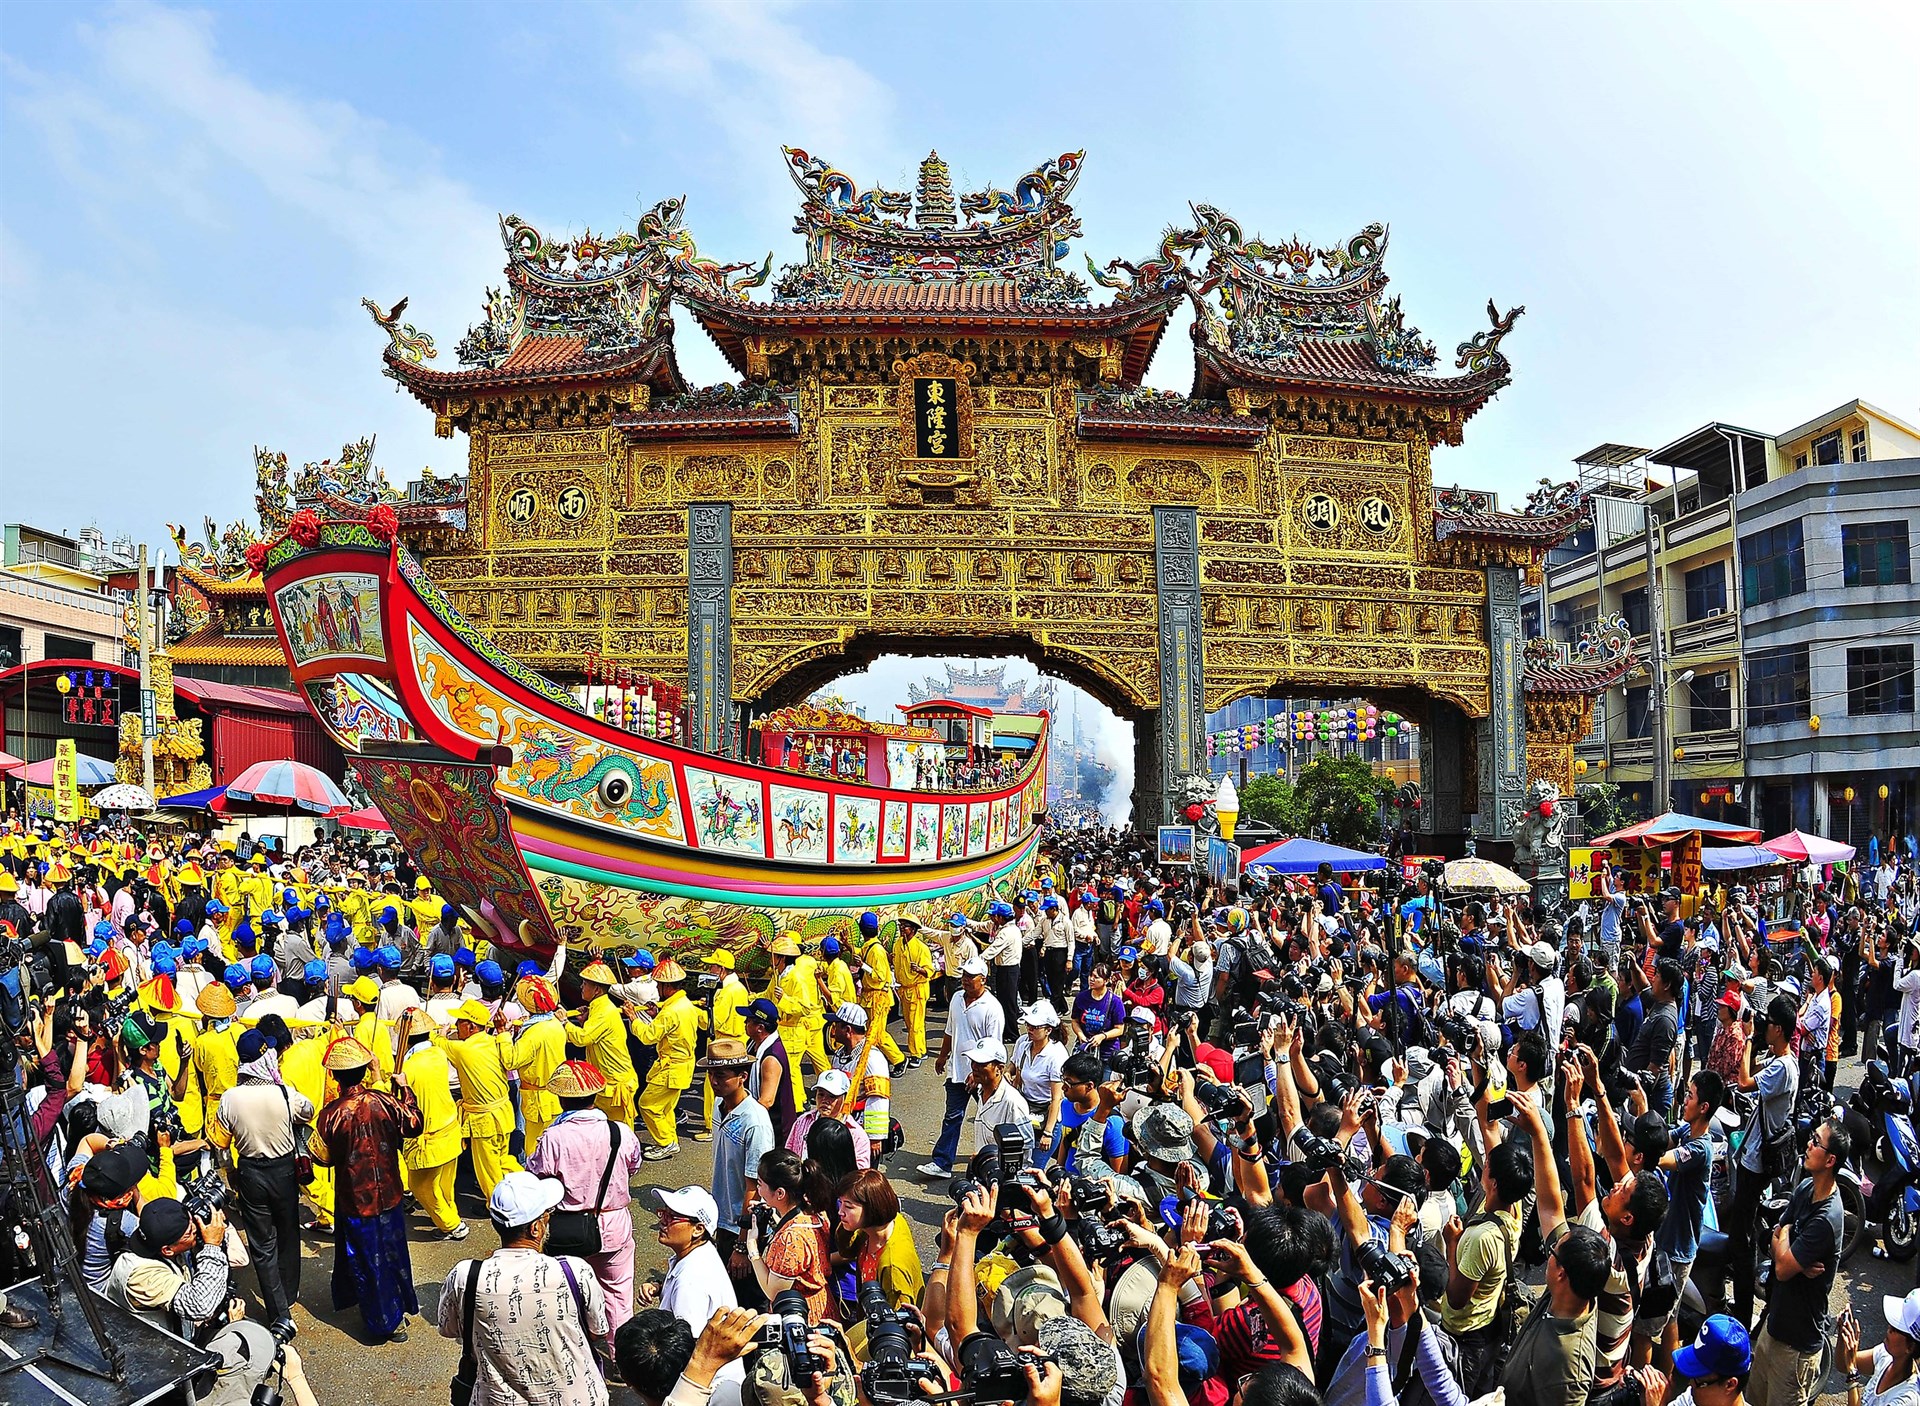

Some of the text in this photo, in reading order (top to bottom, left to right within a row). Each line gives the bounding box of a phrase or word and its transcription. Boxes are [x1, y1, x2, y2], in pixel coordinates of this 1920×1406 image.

[926, 380, 946, 455] 東隆宮
[1572, 863, 1589, 885] 烤
[1622, 849, 1643, 895] 玉米
[1685, 835, 1700, 896] 玉米
